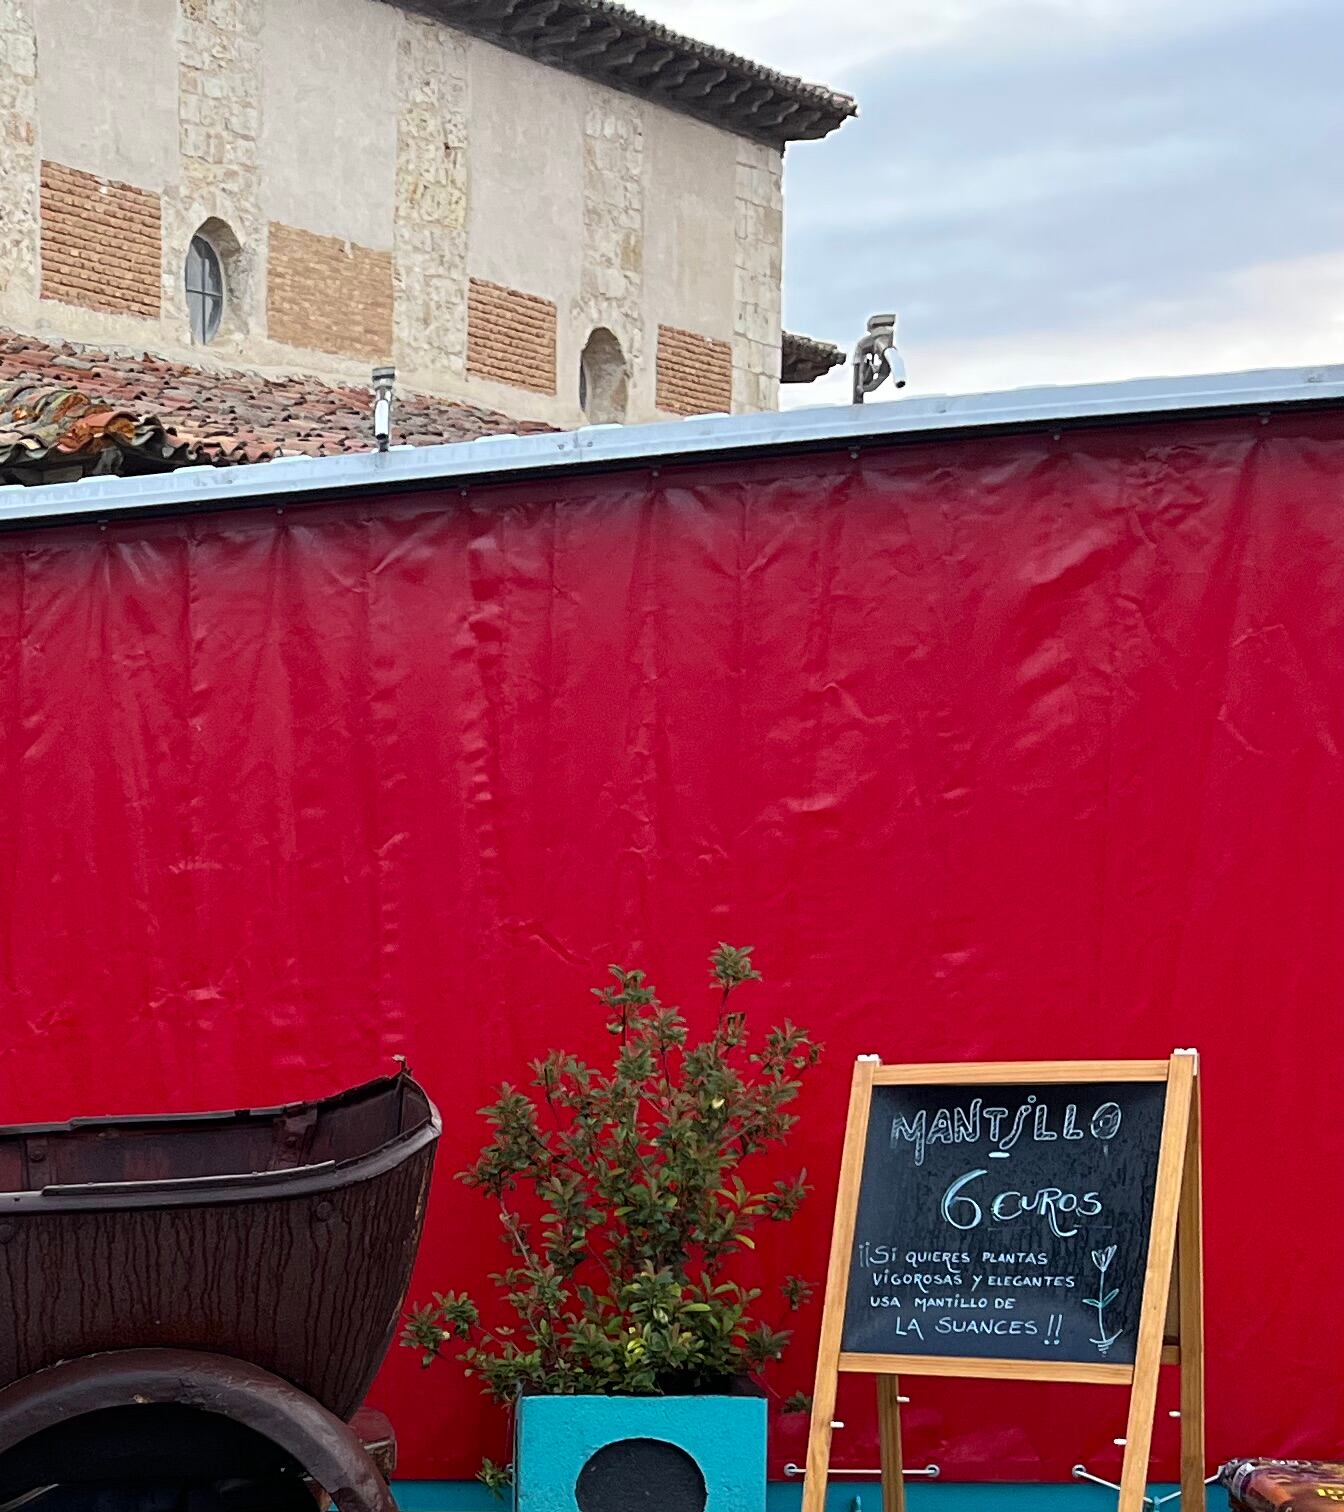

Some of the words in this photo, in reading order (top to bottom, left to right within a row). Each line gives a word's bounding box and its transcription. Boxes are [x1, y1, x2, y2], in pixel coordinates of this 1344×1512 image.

[941, 1169, 988, 1230] 6
[905, 1251, 971, 1274] QUIERES
[982, 1252, 1048, 1265] PLANTAS
[987, 1276, 1076, 1288] ELEGANTES
[870, 1296, 901, 1308] USA
[994, 1299, 1016, 1309] DE
[895, 1316, 925, 1341] LA
[934, 1316, 1038, 1335] SUANCES
